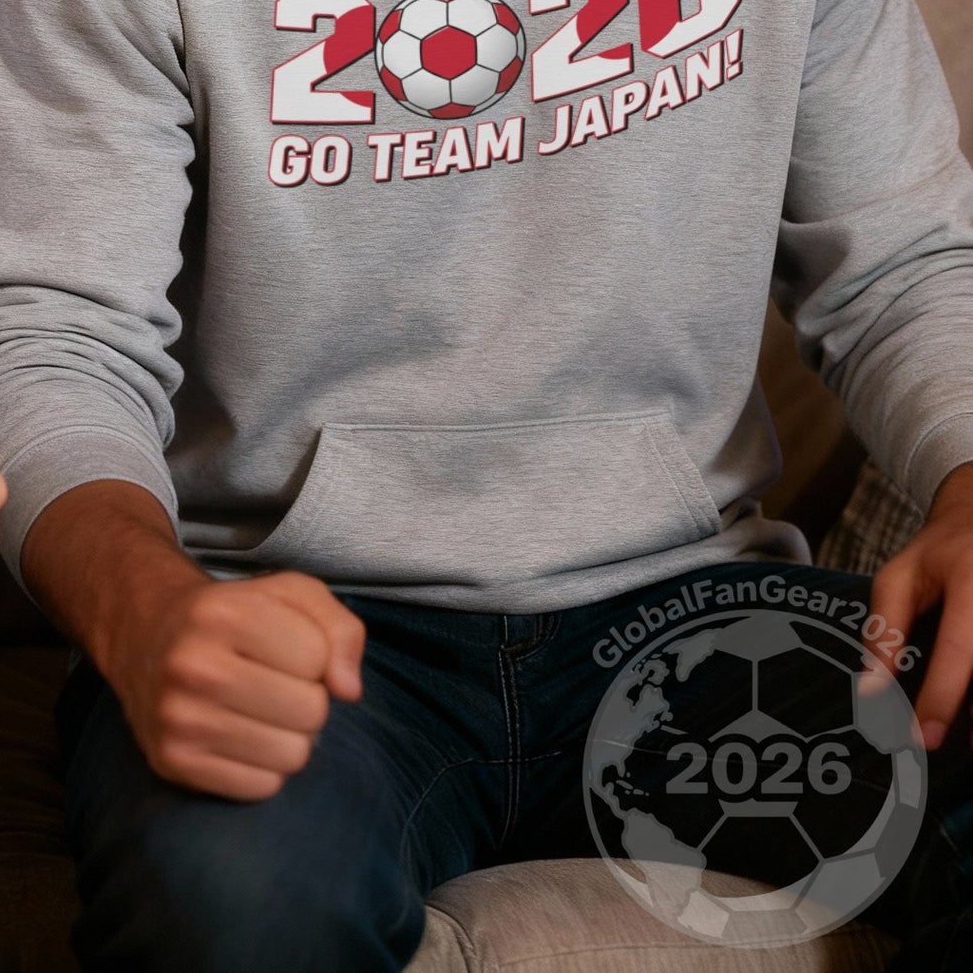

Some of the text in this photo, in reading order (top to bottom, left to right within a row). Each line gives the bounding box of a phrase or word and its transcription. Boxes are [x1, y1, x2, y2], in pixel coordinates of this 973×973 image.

[268, 29, 744, 187] GO TEAM JAPAN!
